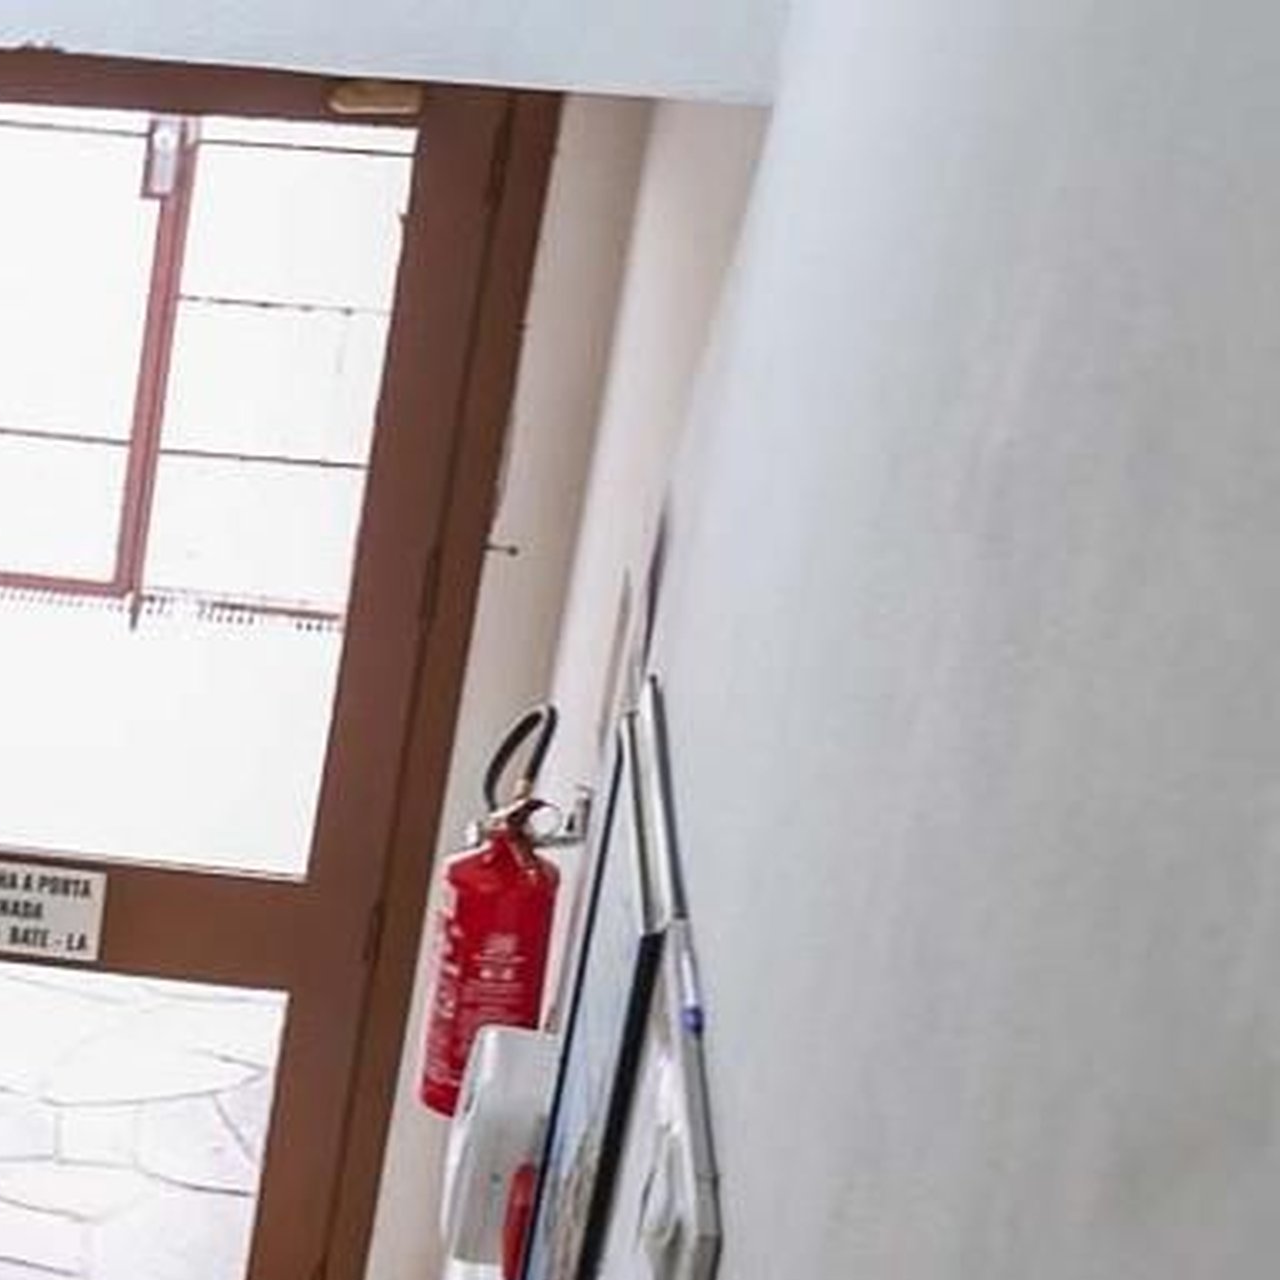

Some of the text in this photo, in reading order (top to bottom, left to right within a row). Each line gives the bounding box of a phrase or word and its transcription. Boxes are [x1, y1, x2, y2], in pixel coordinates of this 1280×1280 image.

[23, 874, 34, 891] A
[38, 875, 91, 899] PORTA
[9, 926, 50, 949] BATE
[66, 932, 87, 951] LA
